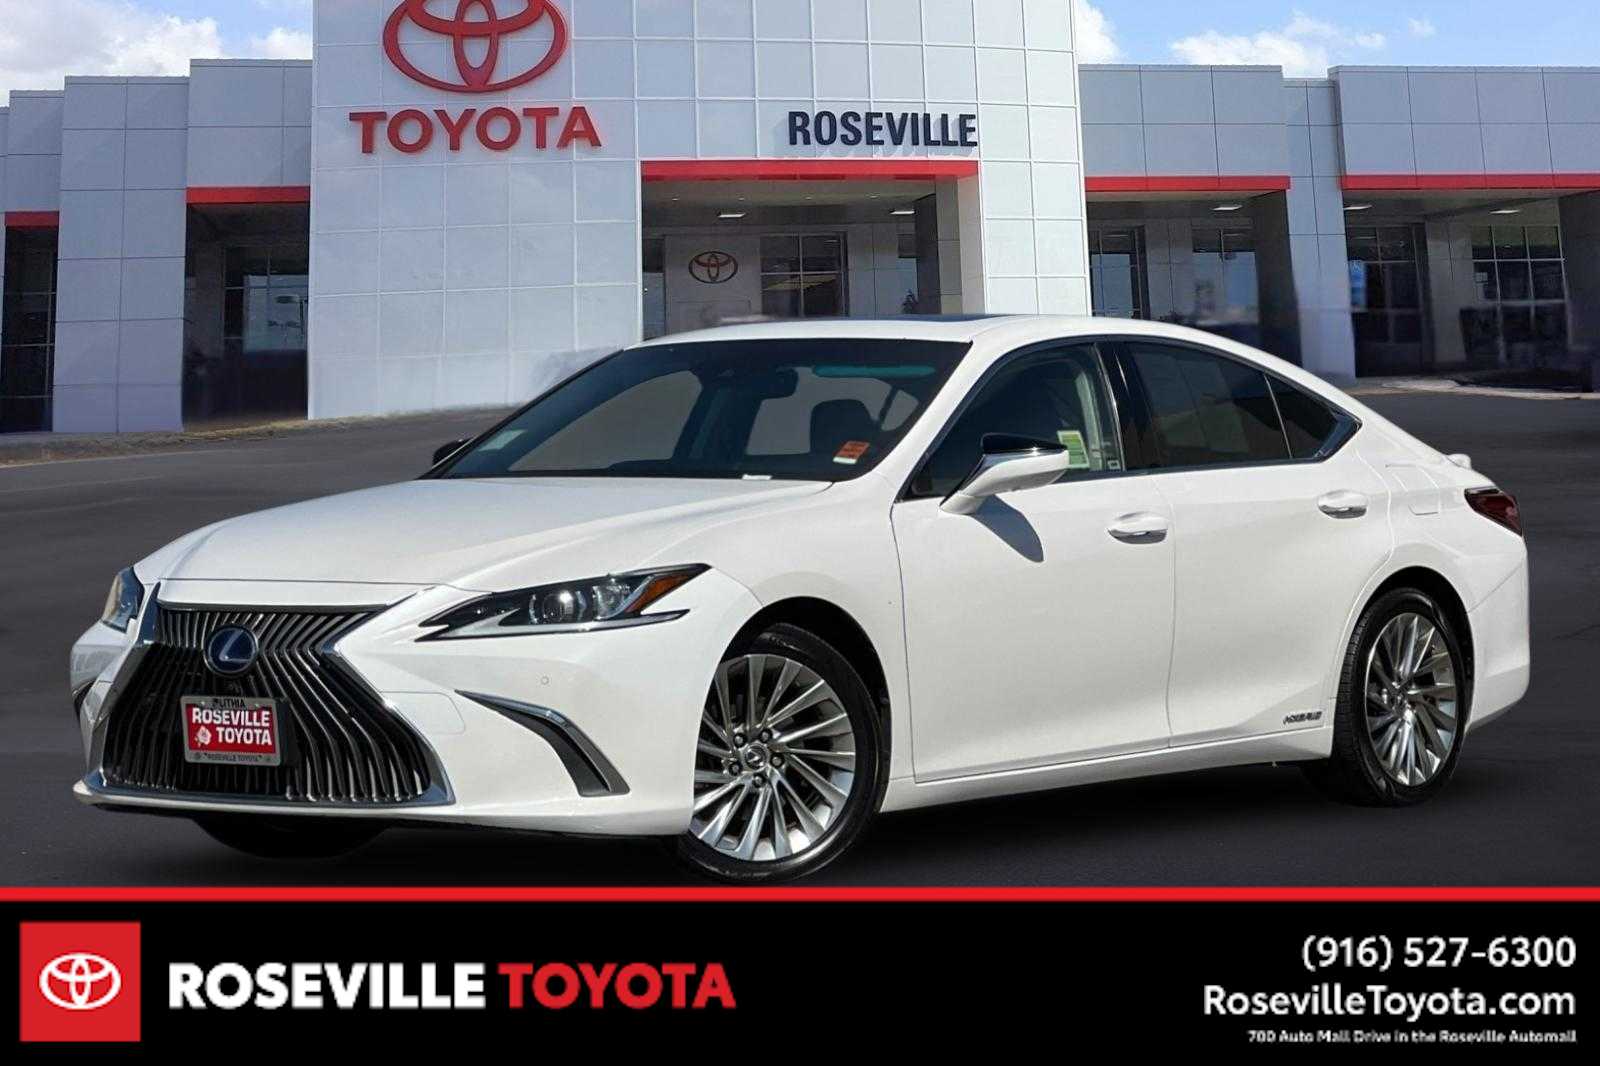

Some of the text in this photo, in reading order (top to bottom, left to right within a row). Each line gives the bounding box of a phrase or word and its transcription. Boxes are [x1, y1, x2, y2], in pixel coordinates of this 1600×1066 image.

[350, 106, 602, 153] TOYOTA
[788, 110, 979, 147] ROSEVILLE
[192, 707, 270, 727] ROSEVILLE
[215, 726, 273, 745] TOYOTA
